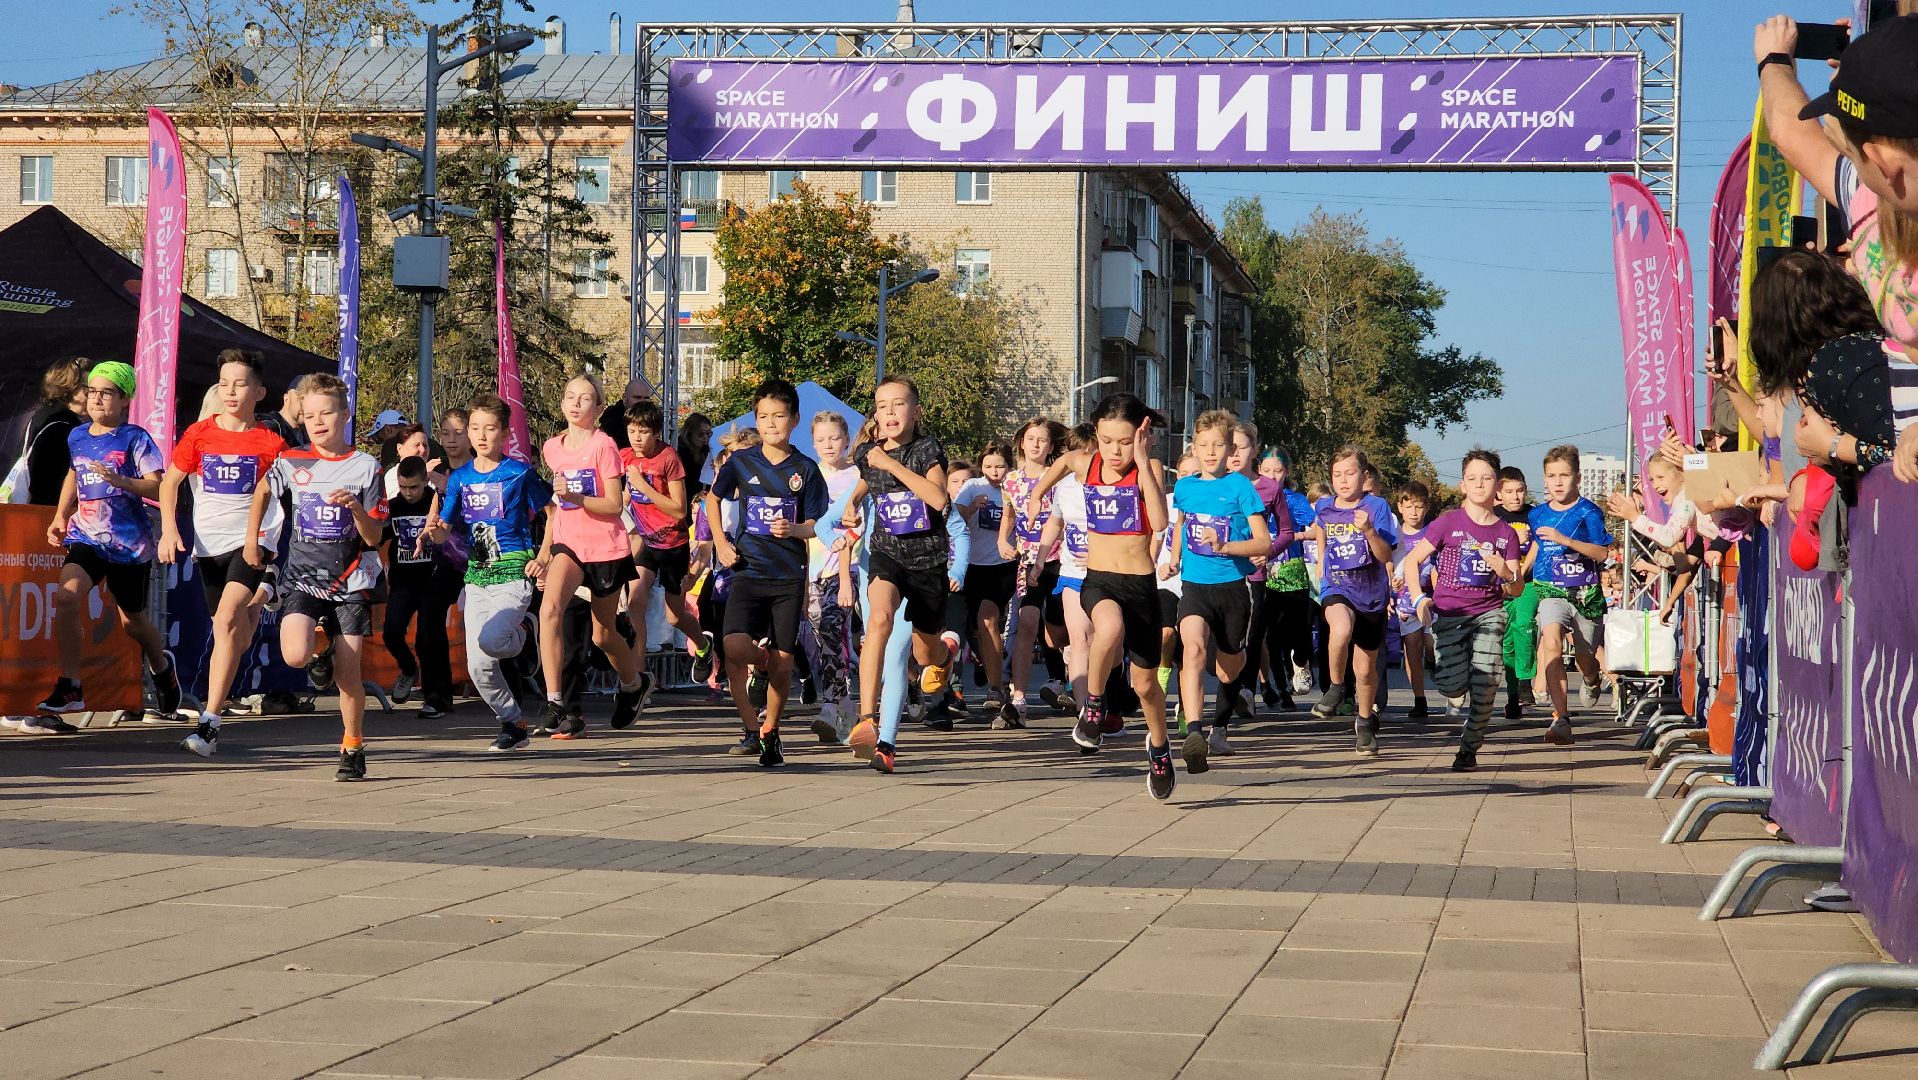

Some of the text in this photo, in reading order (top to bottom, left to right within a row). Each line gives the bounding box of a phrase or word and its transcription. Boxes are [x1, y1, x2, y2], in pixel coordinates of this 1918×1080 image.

[715, 90, 785, 107] SPACE
[1440, 89, 1517, 107] SPACE
[1837, 89, 1865, 120] РЕГБИ
[906, 73, 1384, 152] ФИНИШ
[0, 281, 57, 298] Russia
[216, 466, 240, 480] 115
[467, 494, 490, 507] 139
[1091, 499, 1119, 515] 114
[314, 506, 341, 521] 151
[885, 503, 912, 519] 149
[988, 508, 1003, 519] 15
[1191, 524, 1211, 538] 15
[1334, 543, 1357, 558] 132
[1560, 563, 1585, 575] 108
